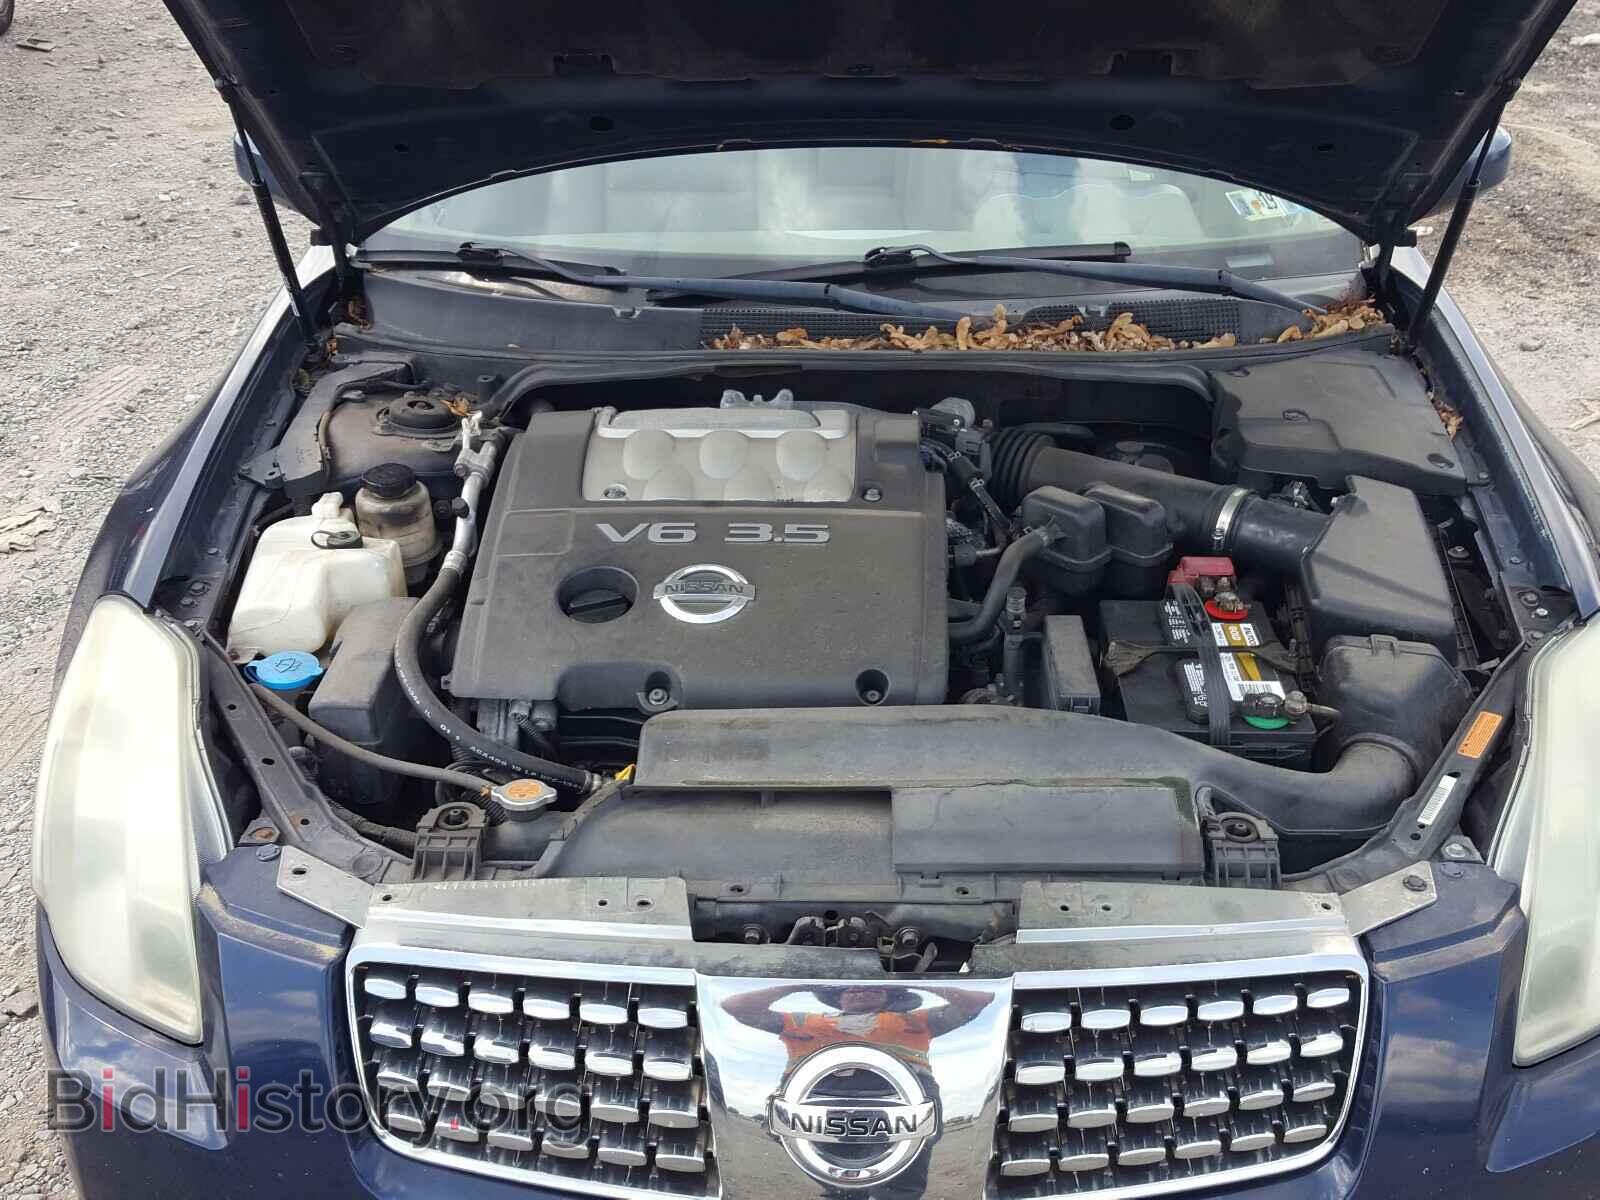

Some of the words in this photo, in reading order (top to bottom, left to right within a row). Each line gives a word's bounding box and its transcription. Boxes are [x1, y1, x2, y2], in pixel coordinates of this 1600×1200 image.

[596, 522, 697, 543] V6
[724, 522, 830, 544] 3.5
[664, 581, 744, 594] NISSAN
[791, 1112, 917, 1136] NISSAN
